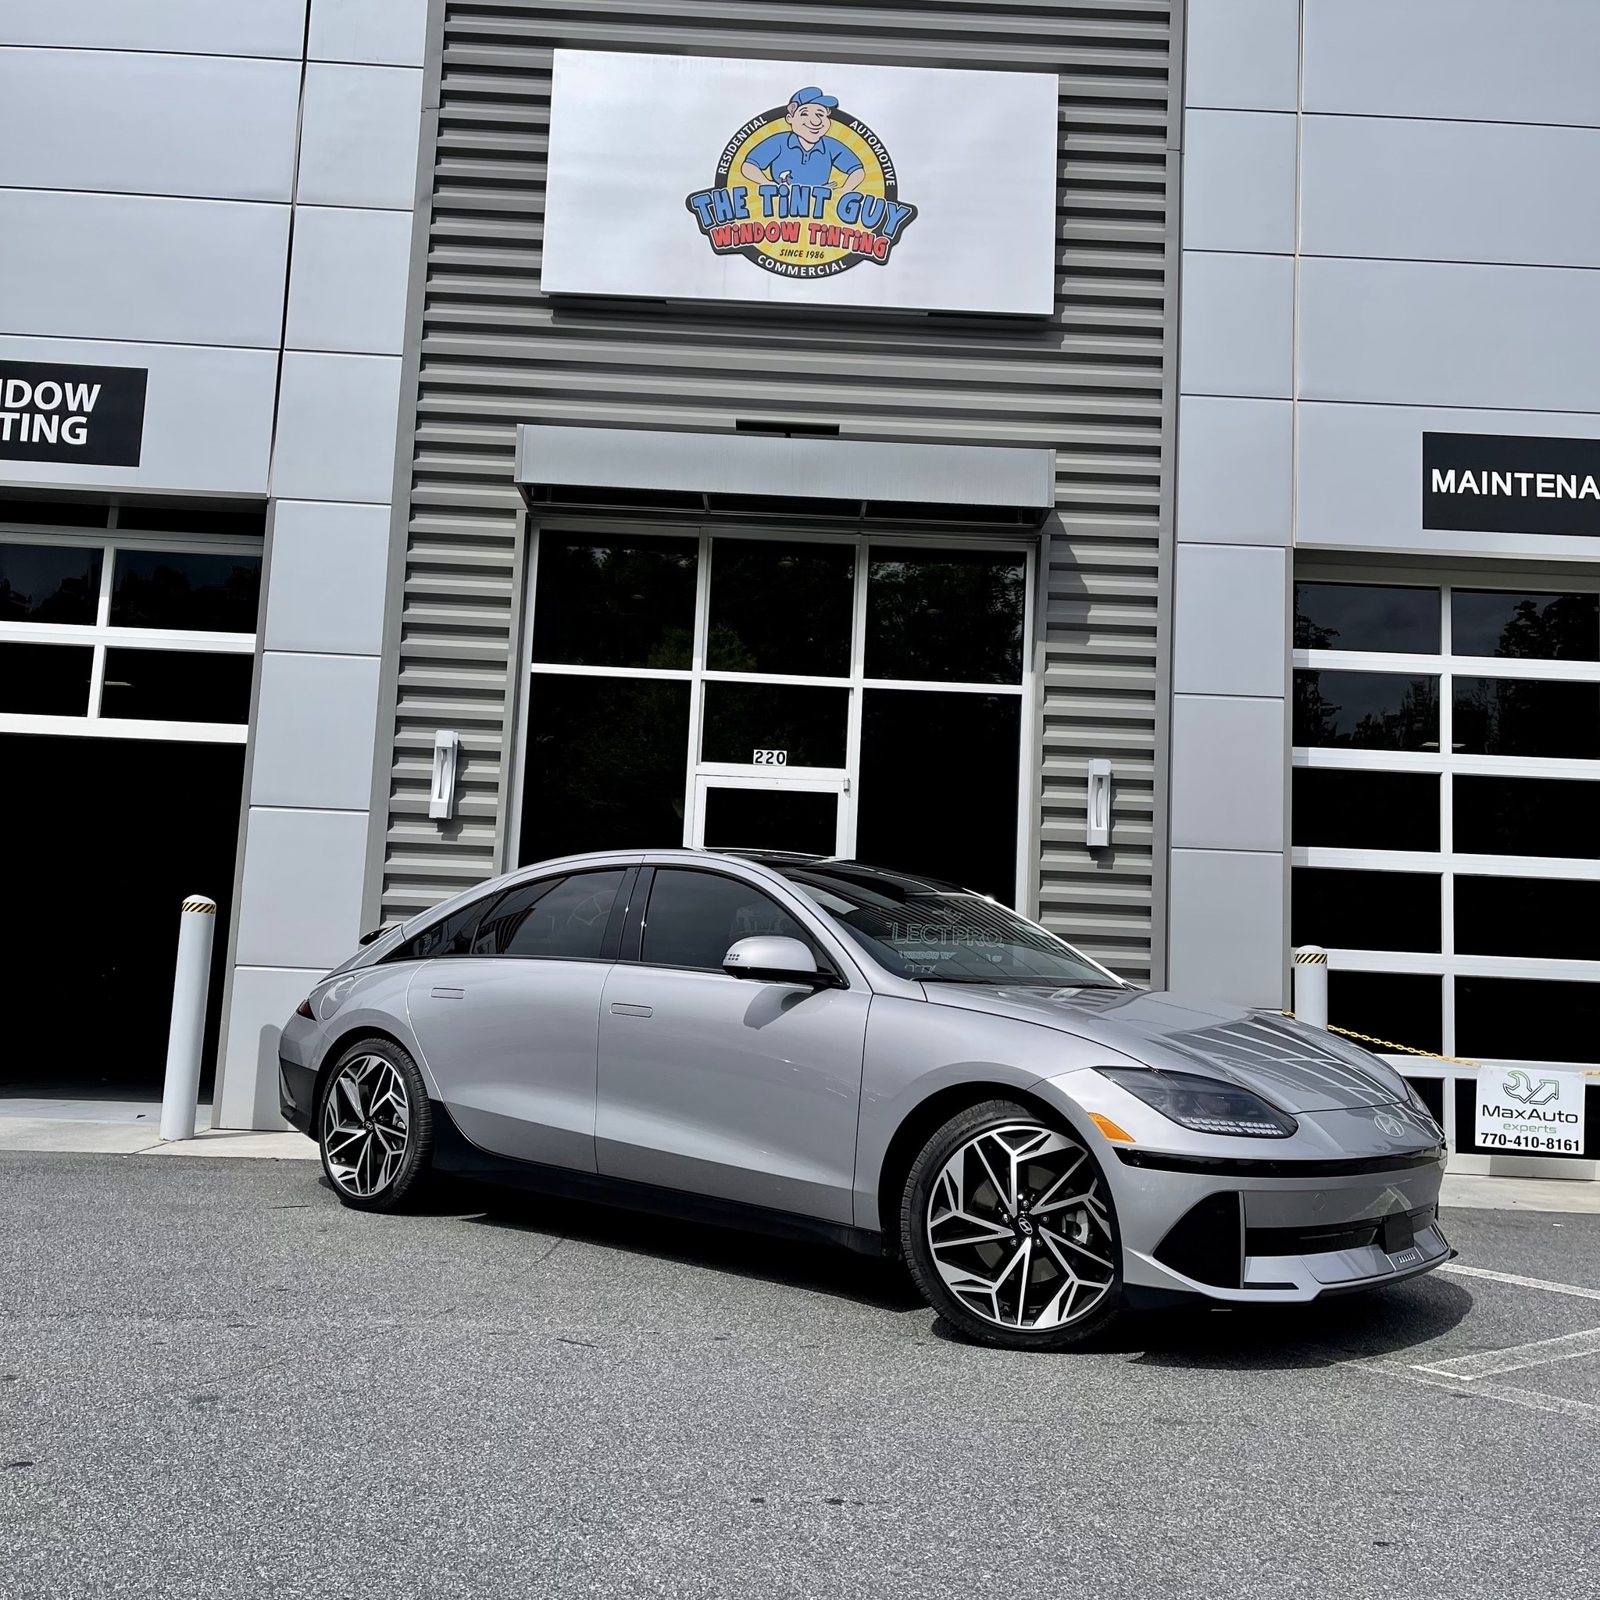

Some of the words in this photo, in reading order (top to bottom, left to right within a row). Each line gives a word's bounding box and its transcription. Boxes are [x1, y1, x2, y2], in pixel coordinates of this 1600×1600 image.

[718, 116, 768, 175] RESIDENTIAL
[849, 120, 896, 186] AUTOMOTIVE
[692, 186, 750, 227] THE
[836, 191, 912, 237] GUY
[779, 249, 804, 258] SINCE
[805, 250, 825, 259] 1986
[757, 254, 847, 276] COMMERCIAL
[755, 751, 786, 765] 220
[1482, 1104, 1579, 1124] MaxAuto
[1503, 1123, 1557, 1134] experts
[1481, 1132, 1579, 1151] 770-410-8161
